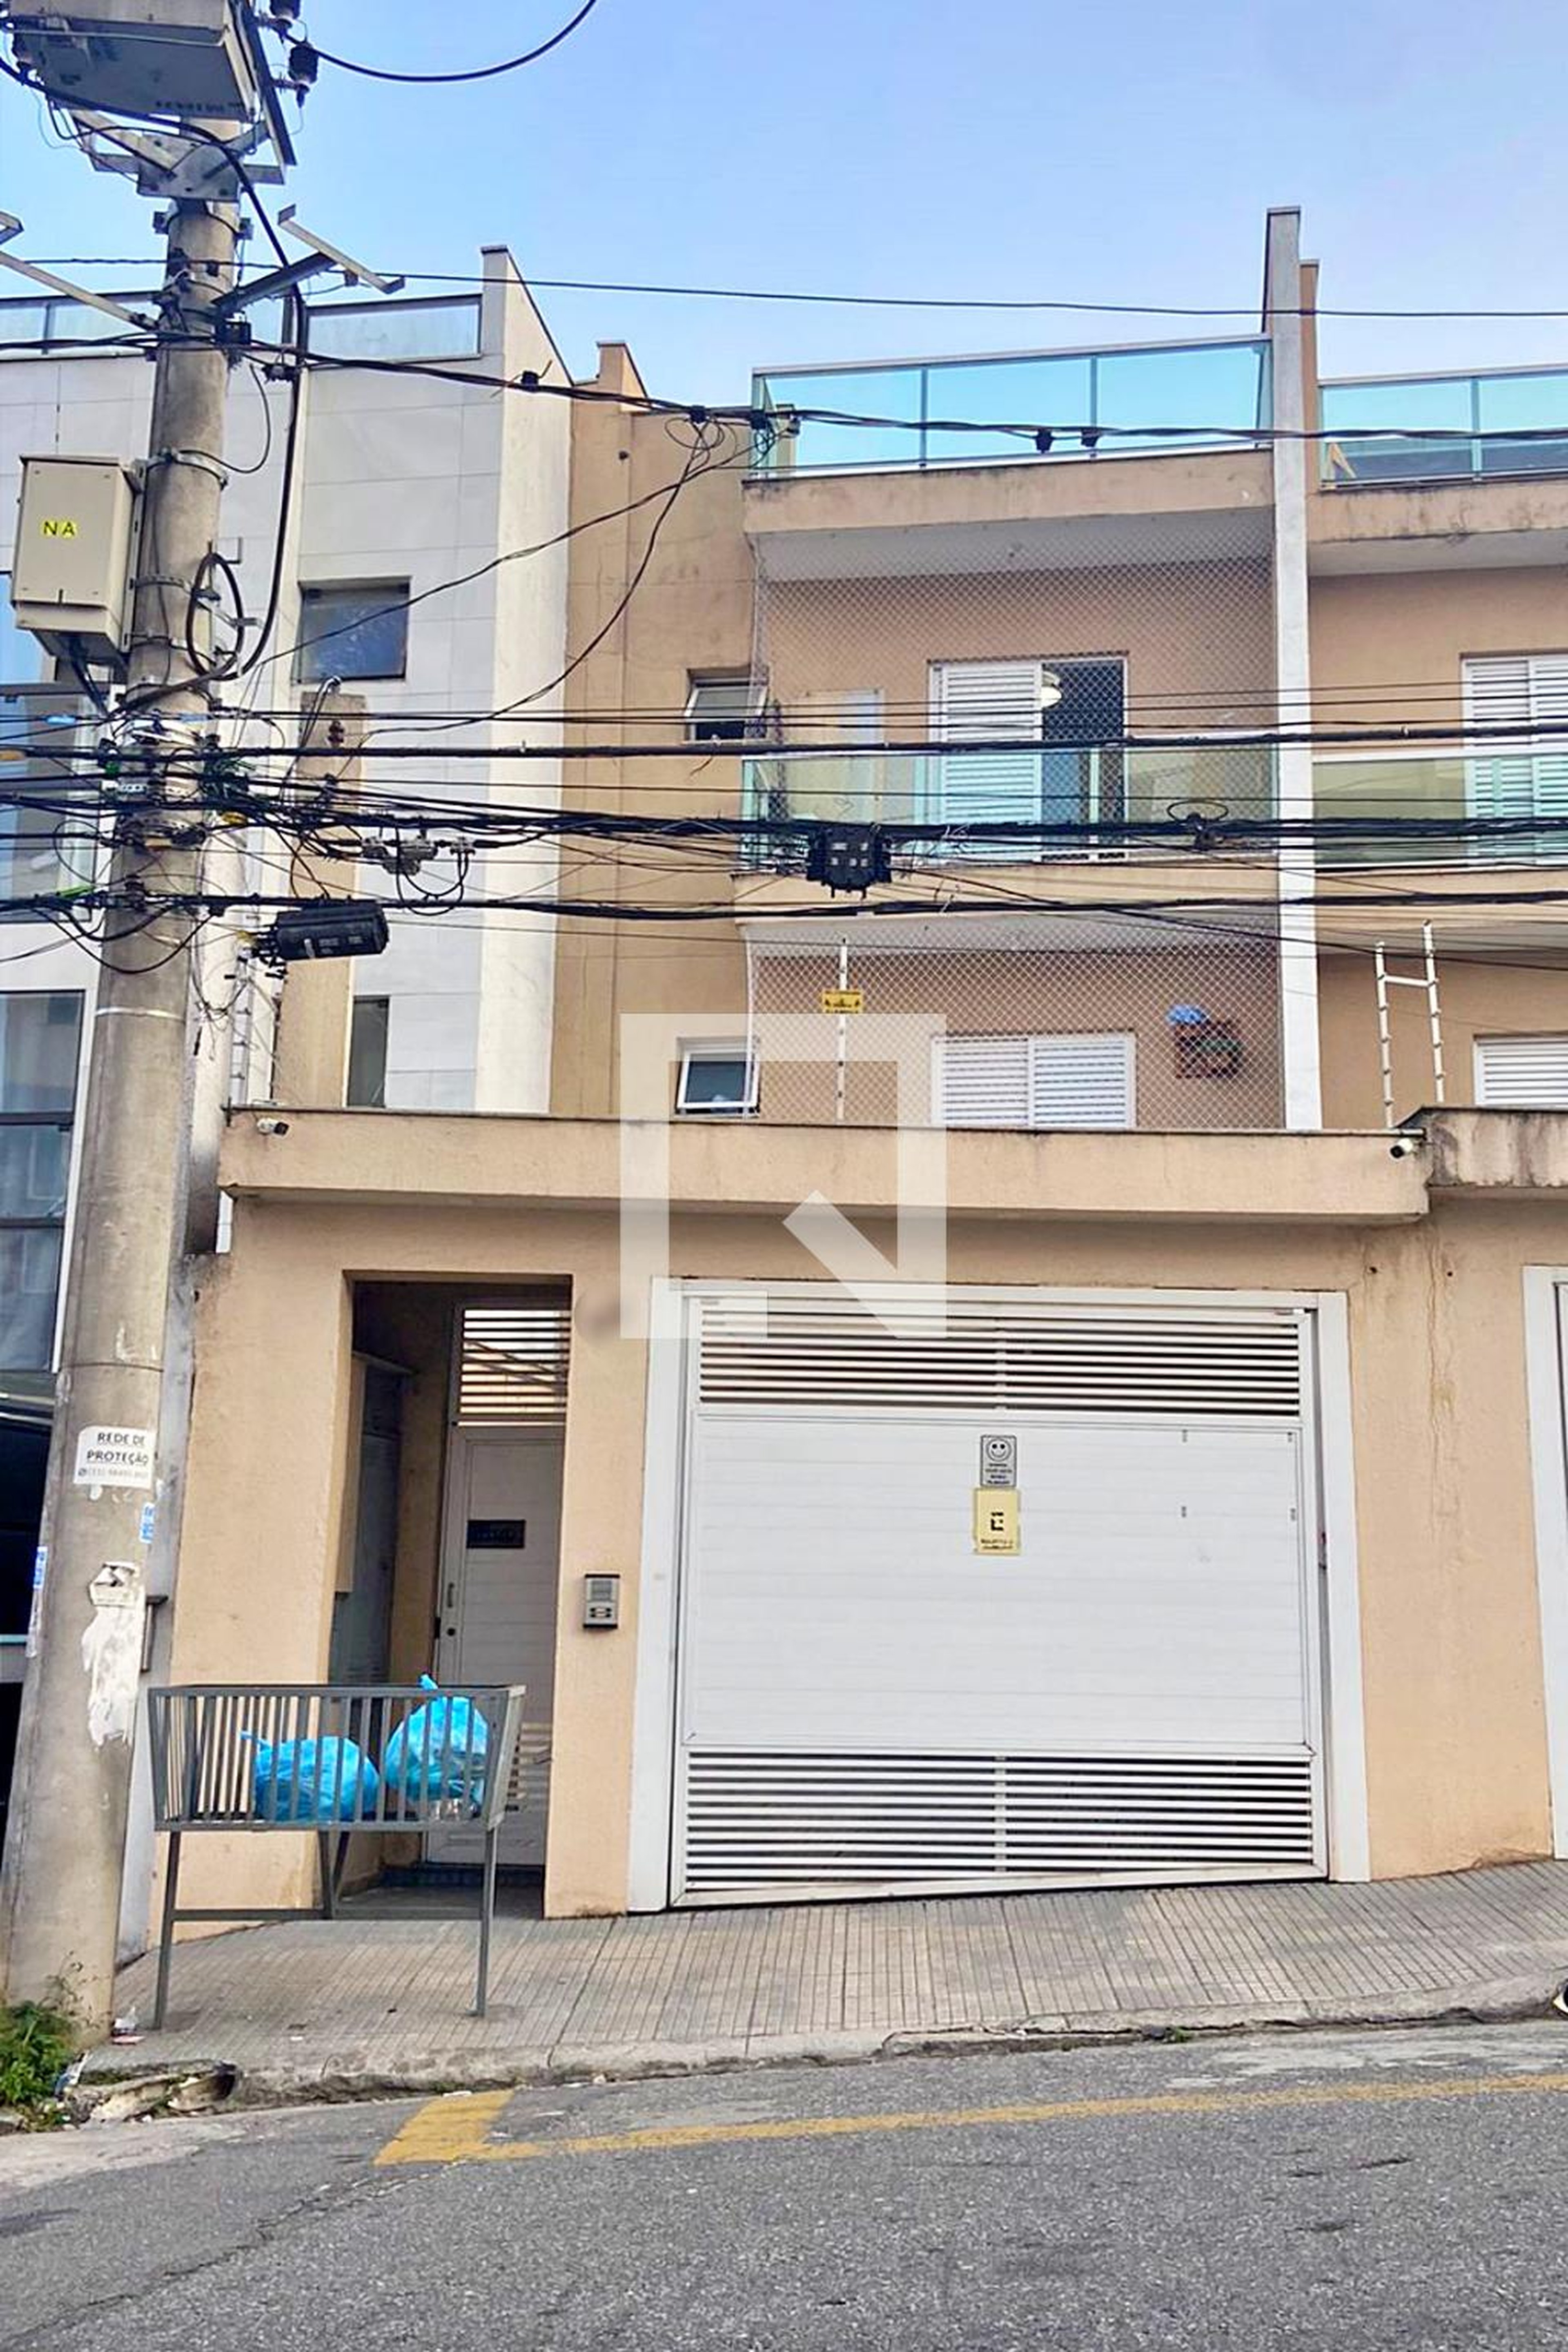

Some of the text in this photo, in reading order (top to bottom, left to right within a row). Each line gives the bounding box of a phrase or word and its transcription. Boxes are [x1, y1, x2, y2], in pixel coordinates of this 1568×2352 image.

[44, 522, 75, 535] NA
[97, 1433, 145, 1446] REDE DE
